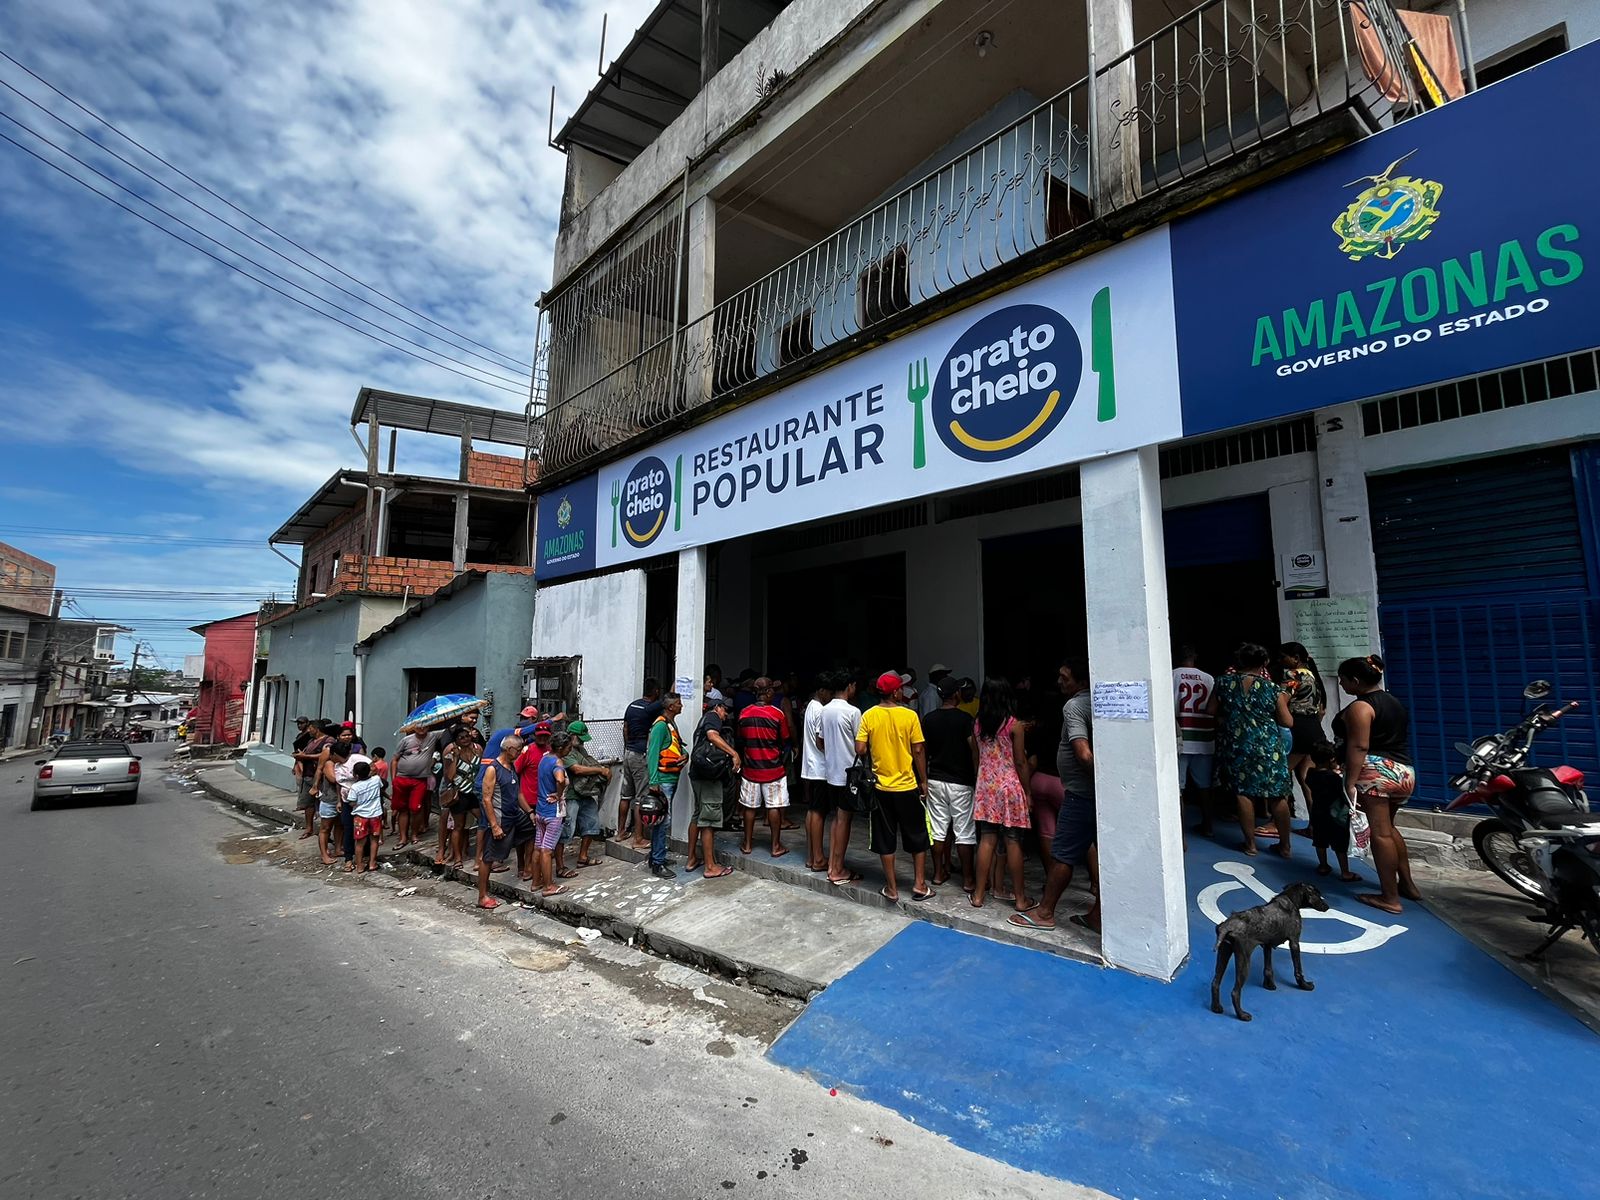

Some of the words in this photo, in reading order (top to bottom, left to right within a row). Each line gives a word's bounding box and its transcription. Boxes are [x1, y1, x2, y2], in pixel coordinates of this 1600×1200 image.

[1251, 223, 1584, 366] AMAZONAS
[949, 323, 1055, 390] prato
[1275, 340, 1388, 378] GOVERNO
[1393, 328, 1432, 348] DO
[1438, 298, 1550, 337] ESTADO
[950, 359, 1057, 415] cheio
[693, 383, 884, 477] RESTAURANTE
[626, 468, 664, 502] prato
[692, 423, 885, 516] POPULAR
[626, 488, 664, 518] cheio
[543, 530, 584, 559] AMAZONAS
[1178, 682, 1208, 714] 22
[1180, 672, 1203, 681] DANIEL
